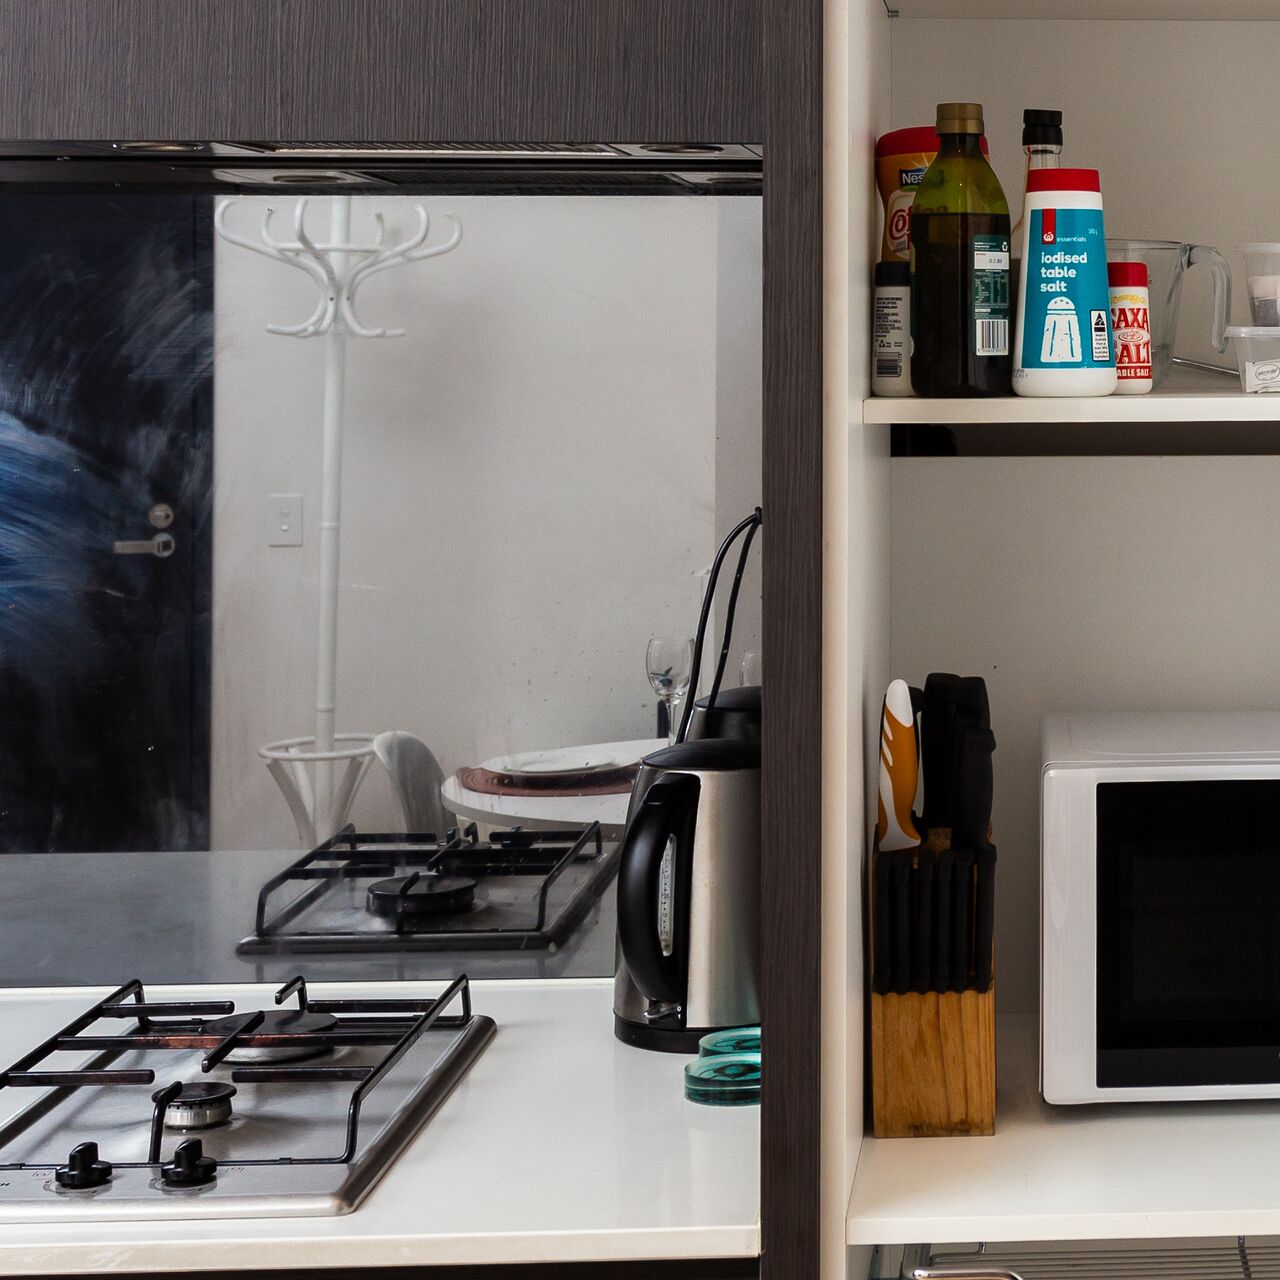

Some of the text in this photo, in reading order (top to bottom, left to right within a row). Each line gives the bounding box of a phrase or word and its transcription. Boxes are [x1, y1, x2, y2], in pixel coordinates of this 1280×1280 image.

[902, 172, 924, 184] Nes
[1041, 252, 1088, 264] iodised
[1040, 266, 1077, 278] table
[1040, 280, 1067, 292] salt
[1117, 368, 1149, 377] ABLE SALT
